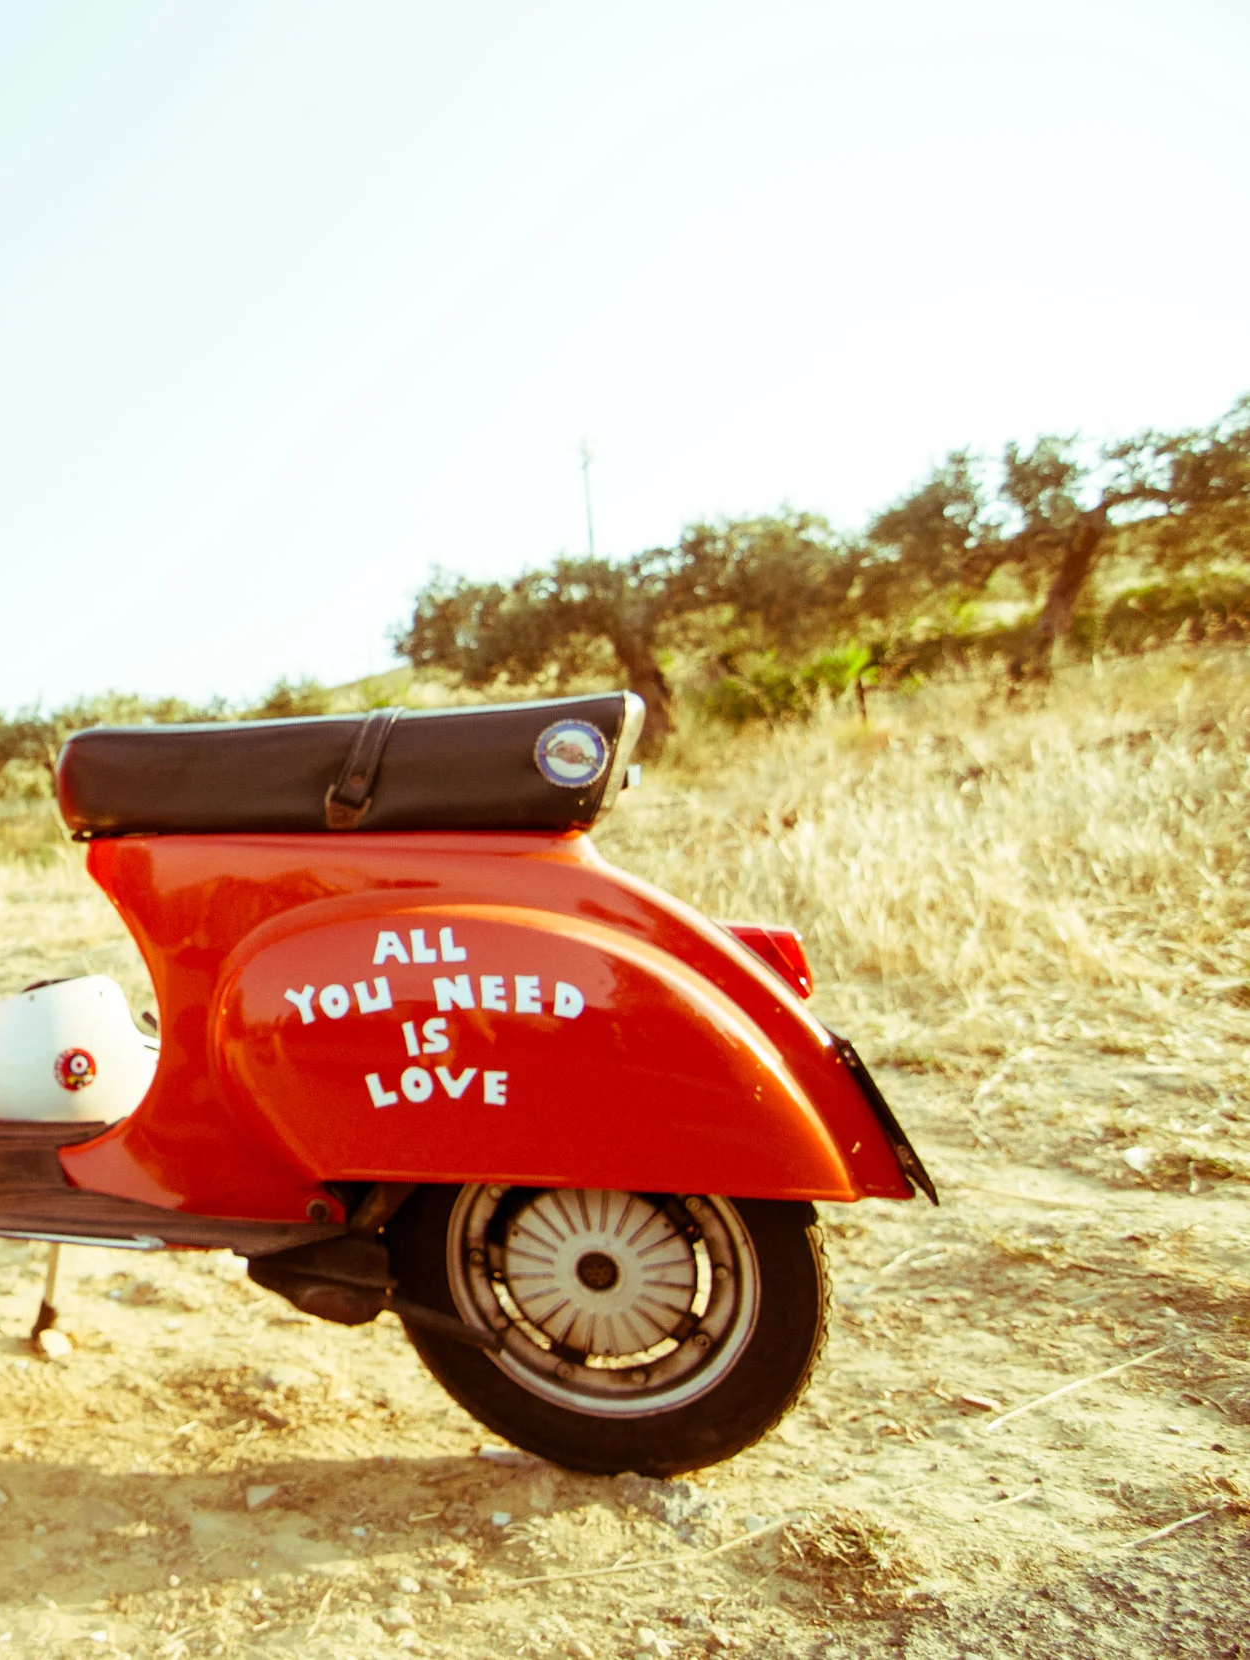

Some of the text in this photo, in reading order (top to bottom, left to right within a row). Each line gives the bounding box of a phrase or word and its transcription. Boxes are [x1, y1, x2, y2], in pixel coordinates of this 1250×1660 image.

[372, 926, 467, 965] ALL
[284, 974, 585, 1024] YOU NEED
[401, 1017, 450, 1057] IS
[364, 1066, 508, 1108] LOVE
